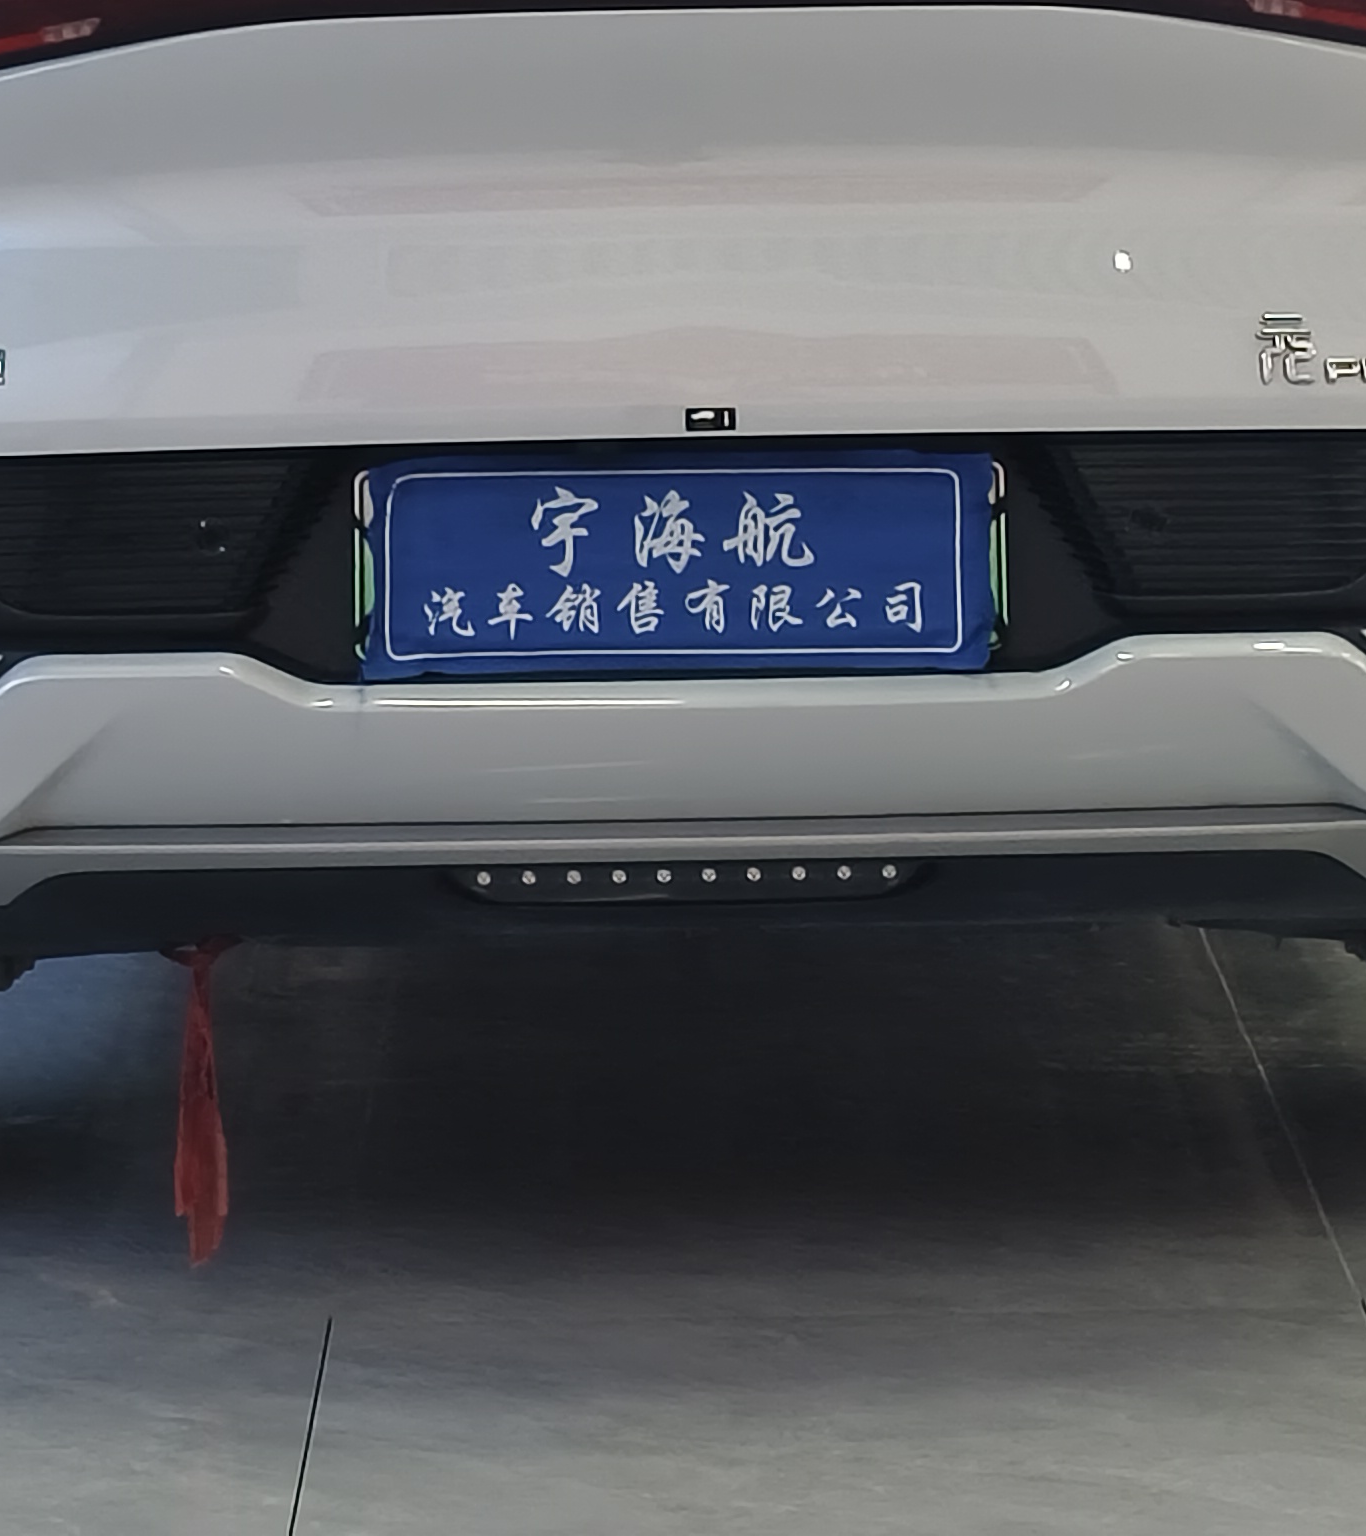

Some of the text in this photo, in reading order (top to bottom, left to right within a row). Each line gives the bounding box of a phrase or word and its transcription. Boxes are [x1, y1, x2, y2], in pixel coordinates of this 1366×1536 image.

[1255, 311, 1317, 385] 元
[530, 486, 815, 577] 宇海航
[422, 579, 924, 641] 汽车销售有限公司
